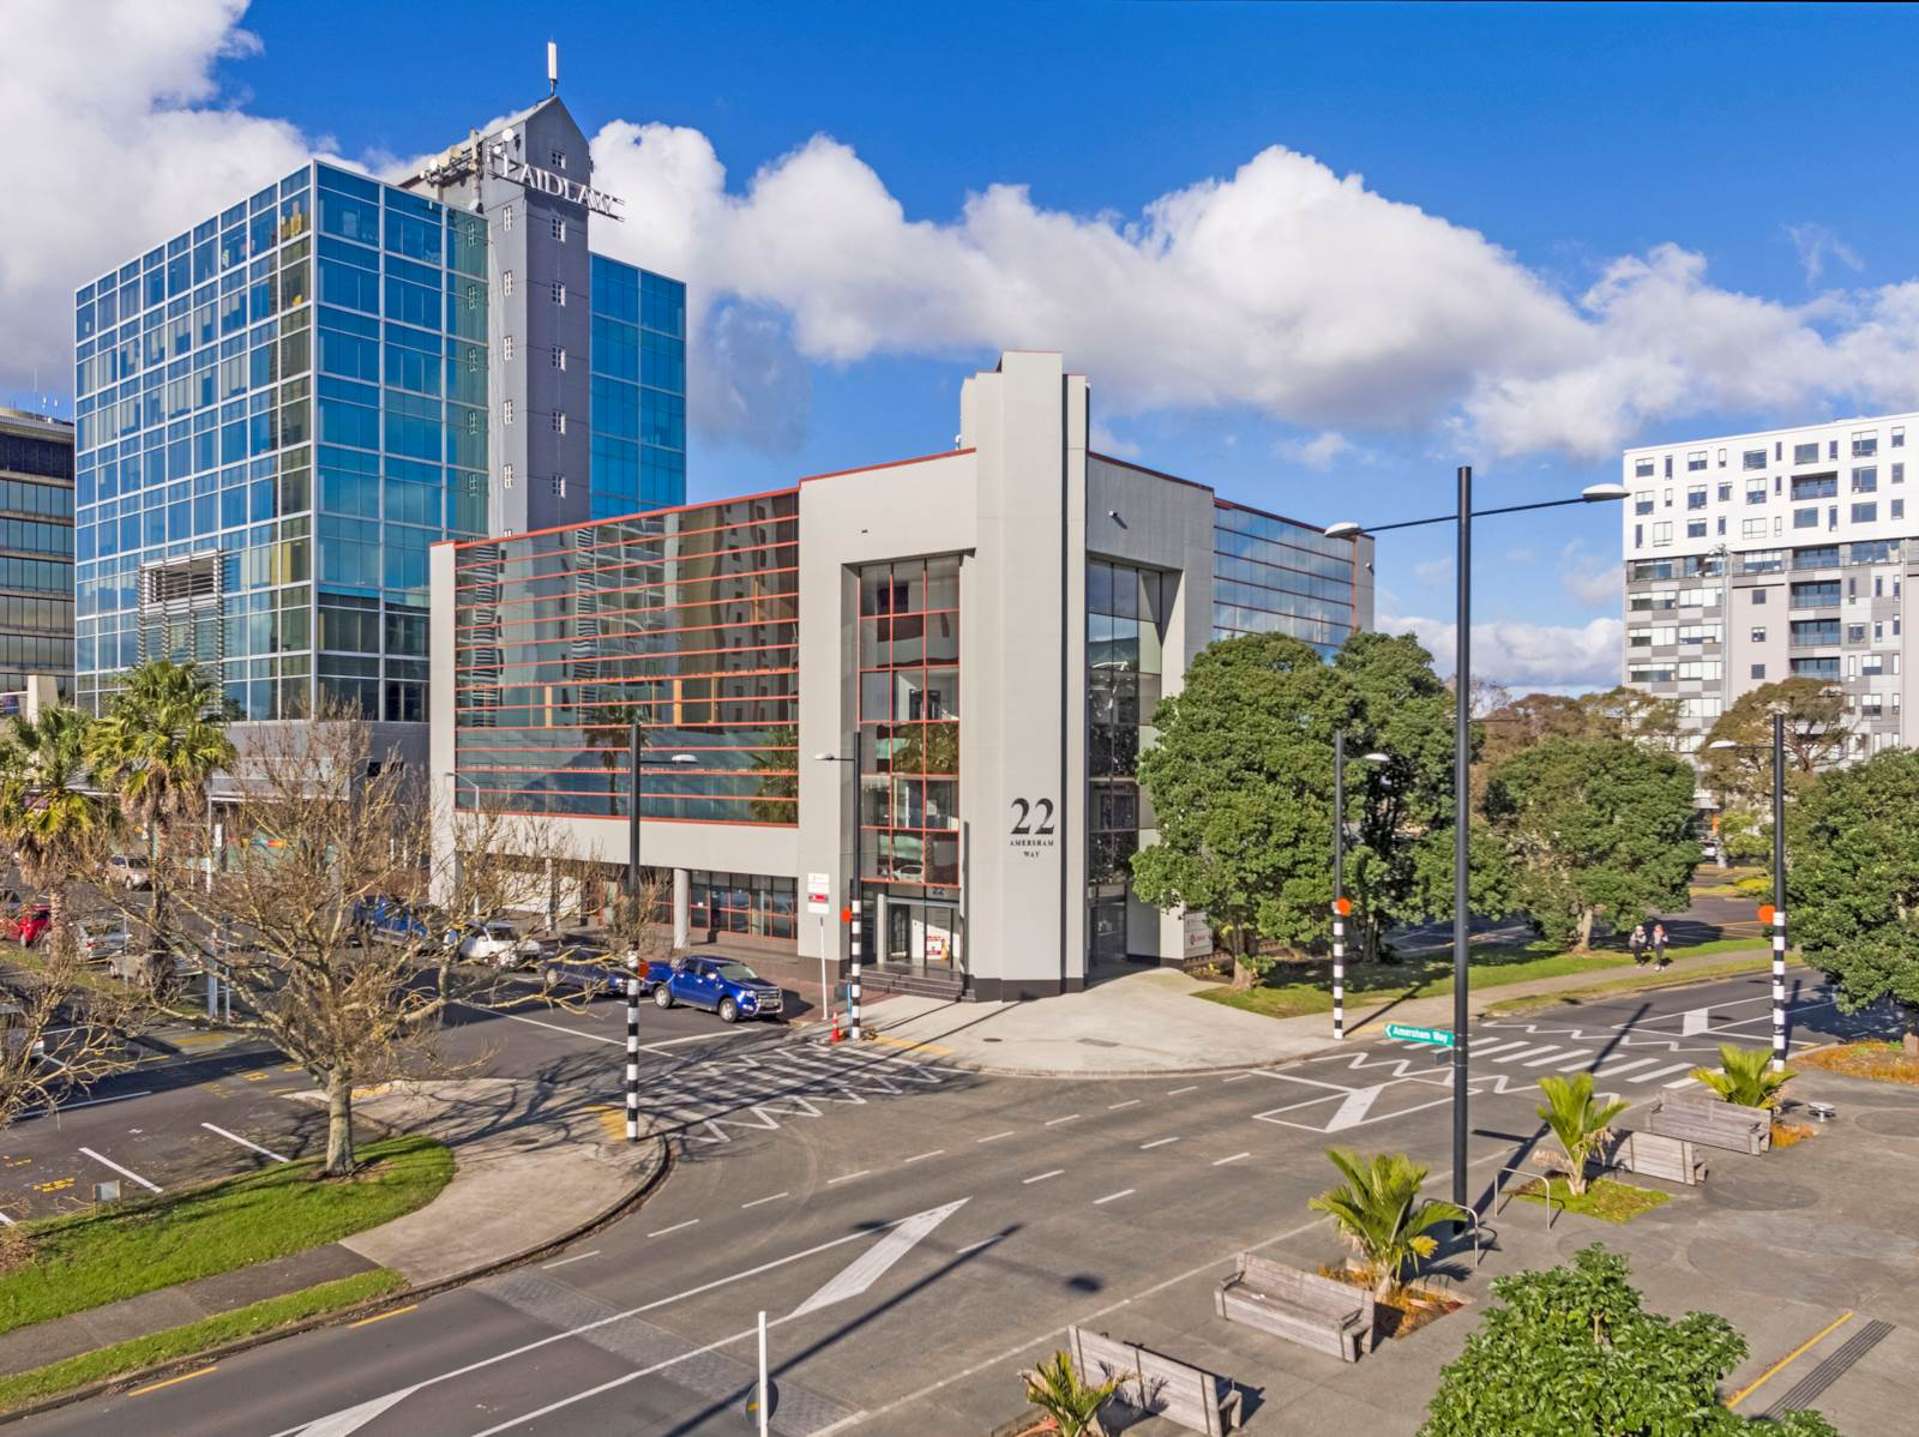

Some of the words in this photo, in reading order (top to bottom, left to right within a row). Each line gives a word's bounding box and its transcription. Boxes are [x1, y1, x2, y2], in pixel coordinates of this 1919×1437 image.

[502, 153, 613, 215] LAIDLAW
[1010, 797, 1055, 835] 22
[1009, 839, 1055, 847] AMERSHAM
[1023, 850, 1040, 858] WAY
